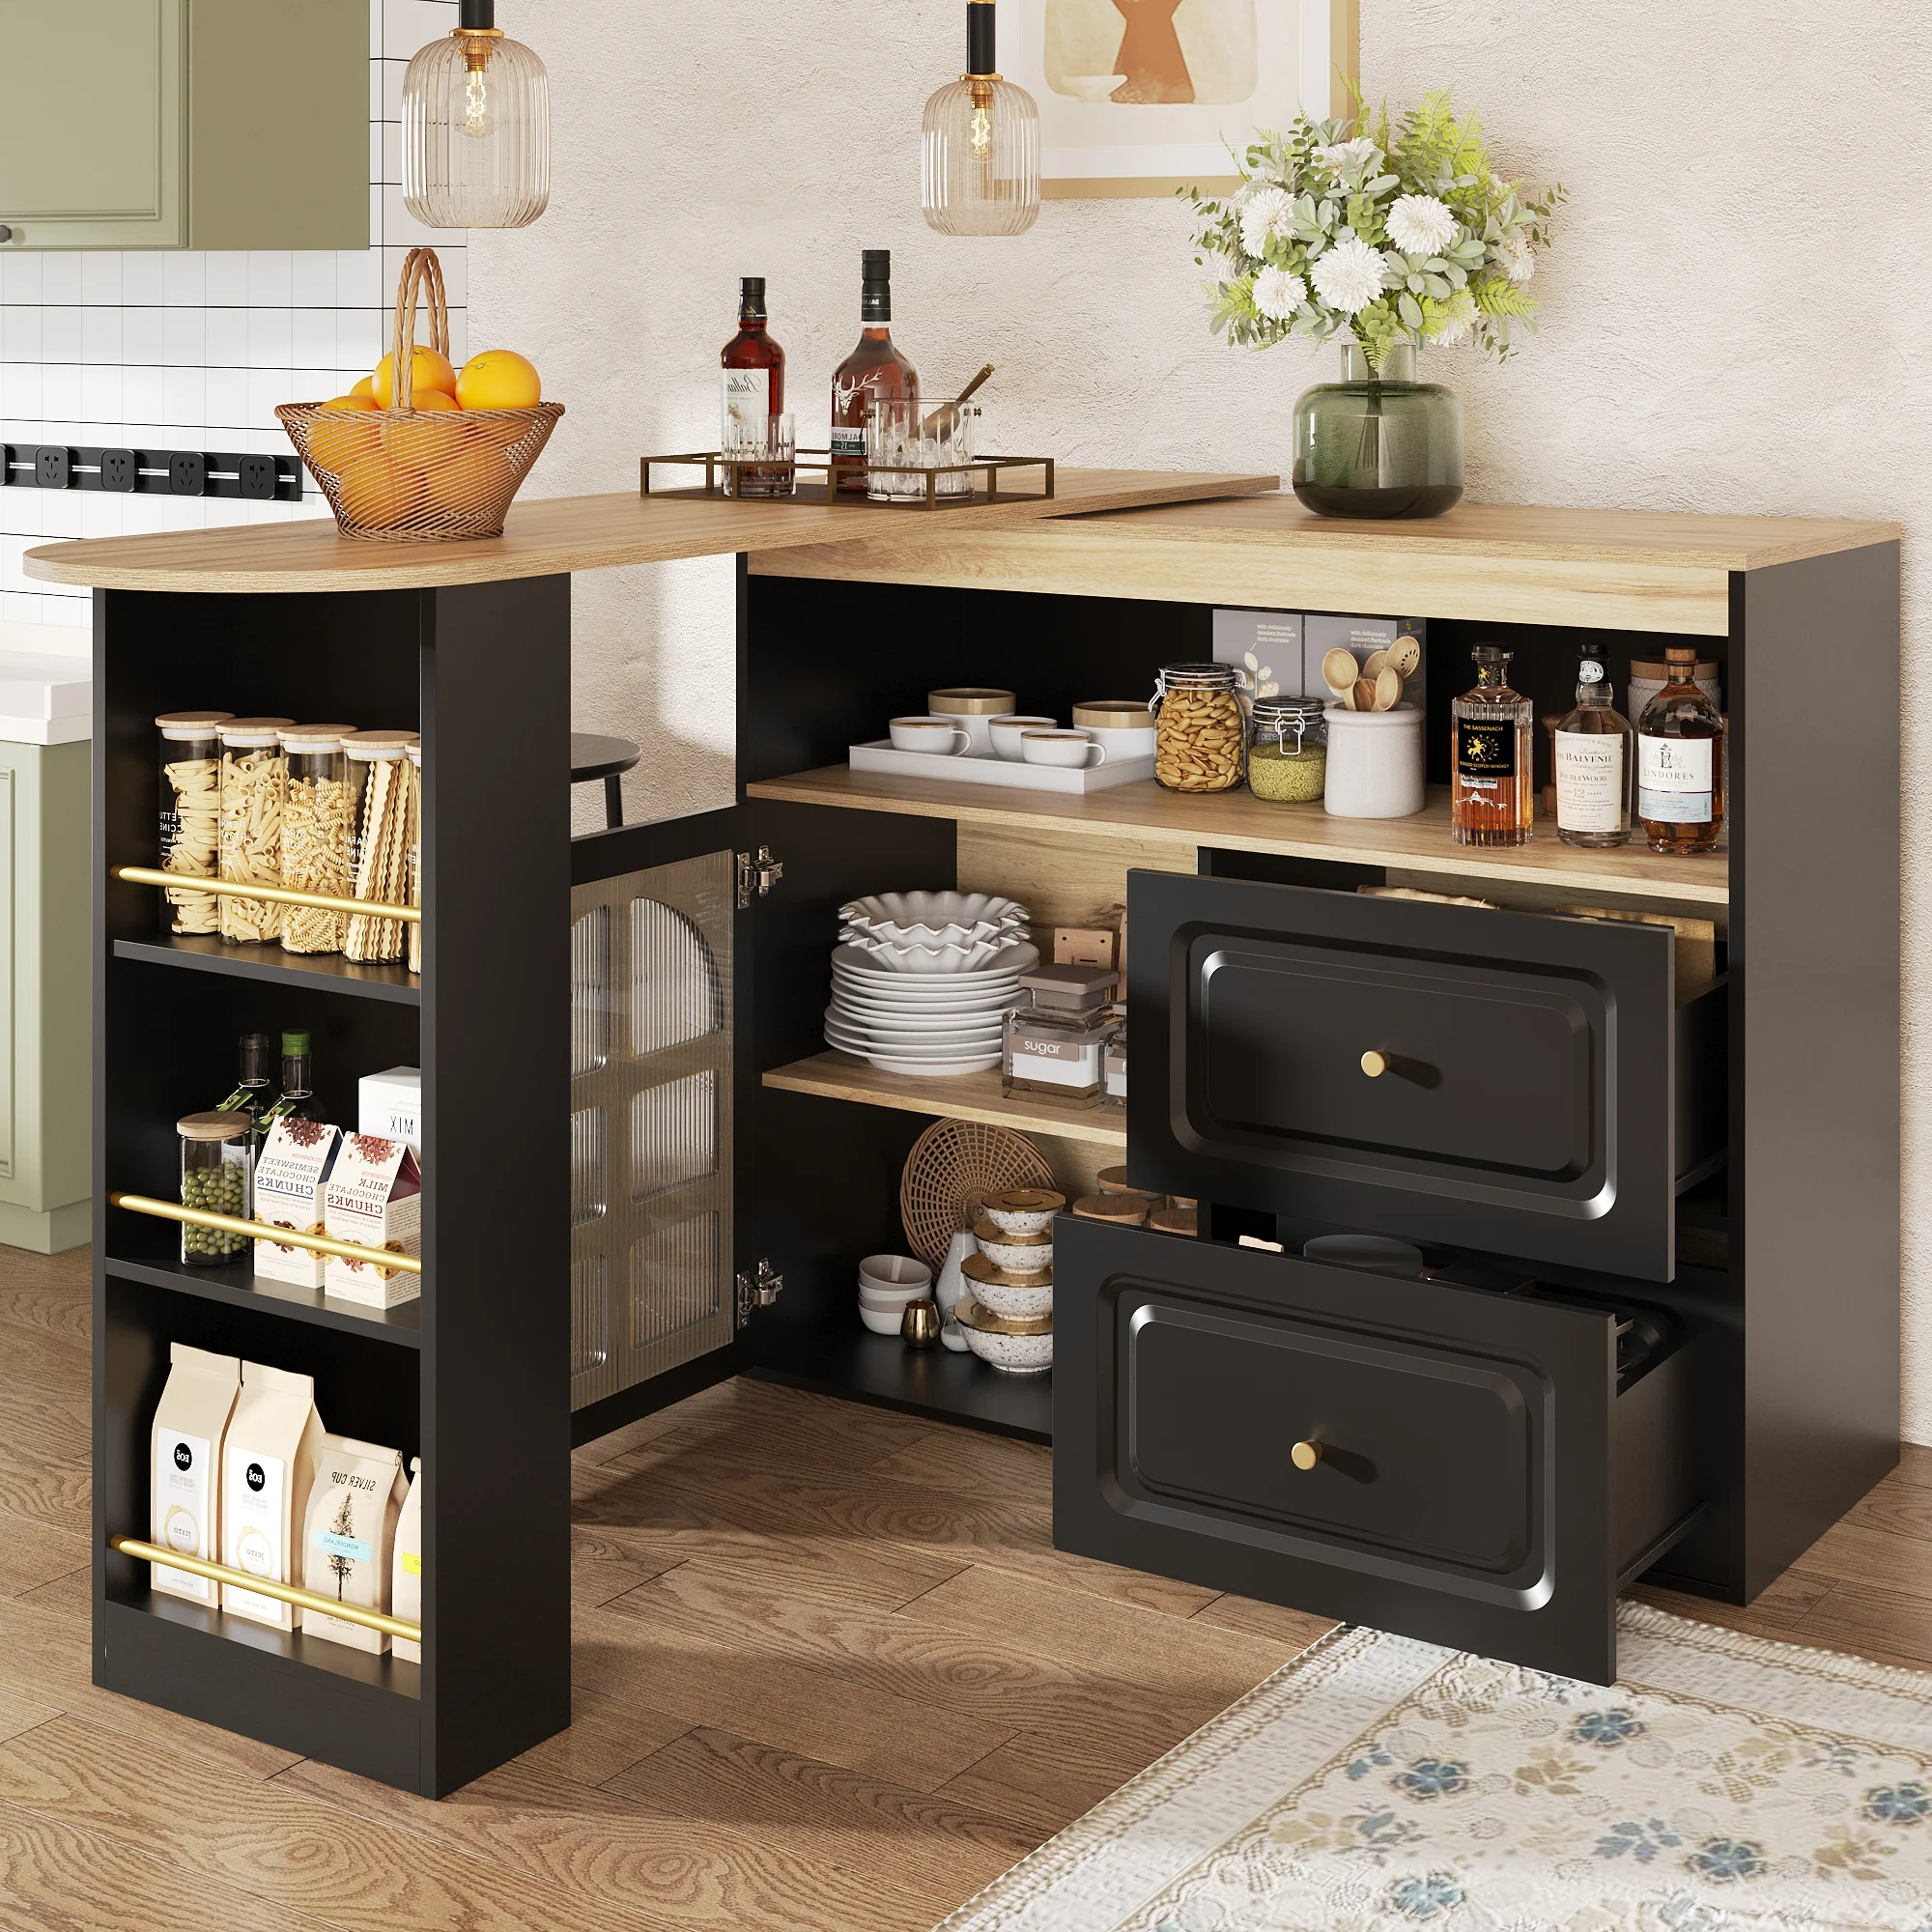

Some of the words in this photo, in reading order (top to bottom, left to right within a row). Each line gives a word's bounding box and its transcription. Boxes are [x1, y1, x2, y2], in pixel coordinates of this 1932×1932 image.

[1566, 753, 1613, 763] BALVENIE
[1643, 768, 1694, 781] LINDORES
[1574, 787, 1585, 799] 12
[1024, 1039, 1062, 1055] sugar
